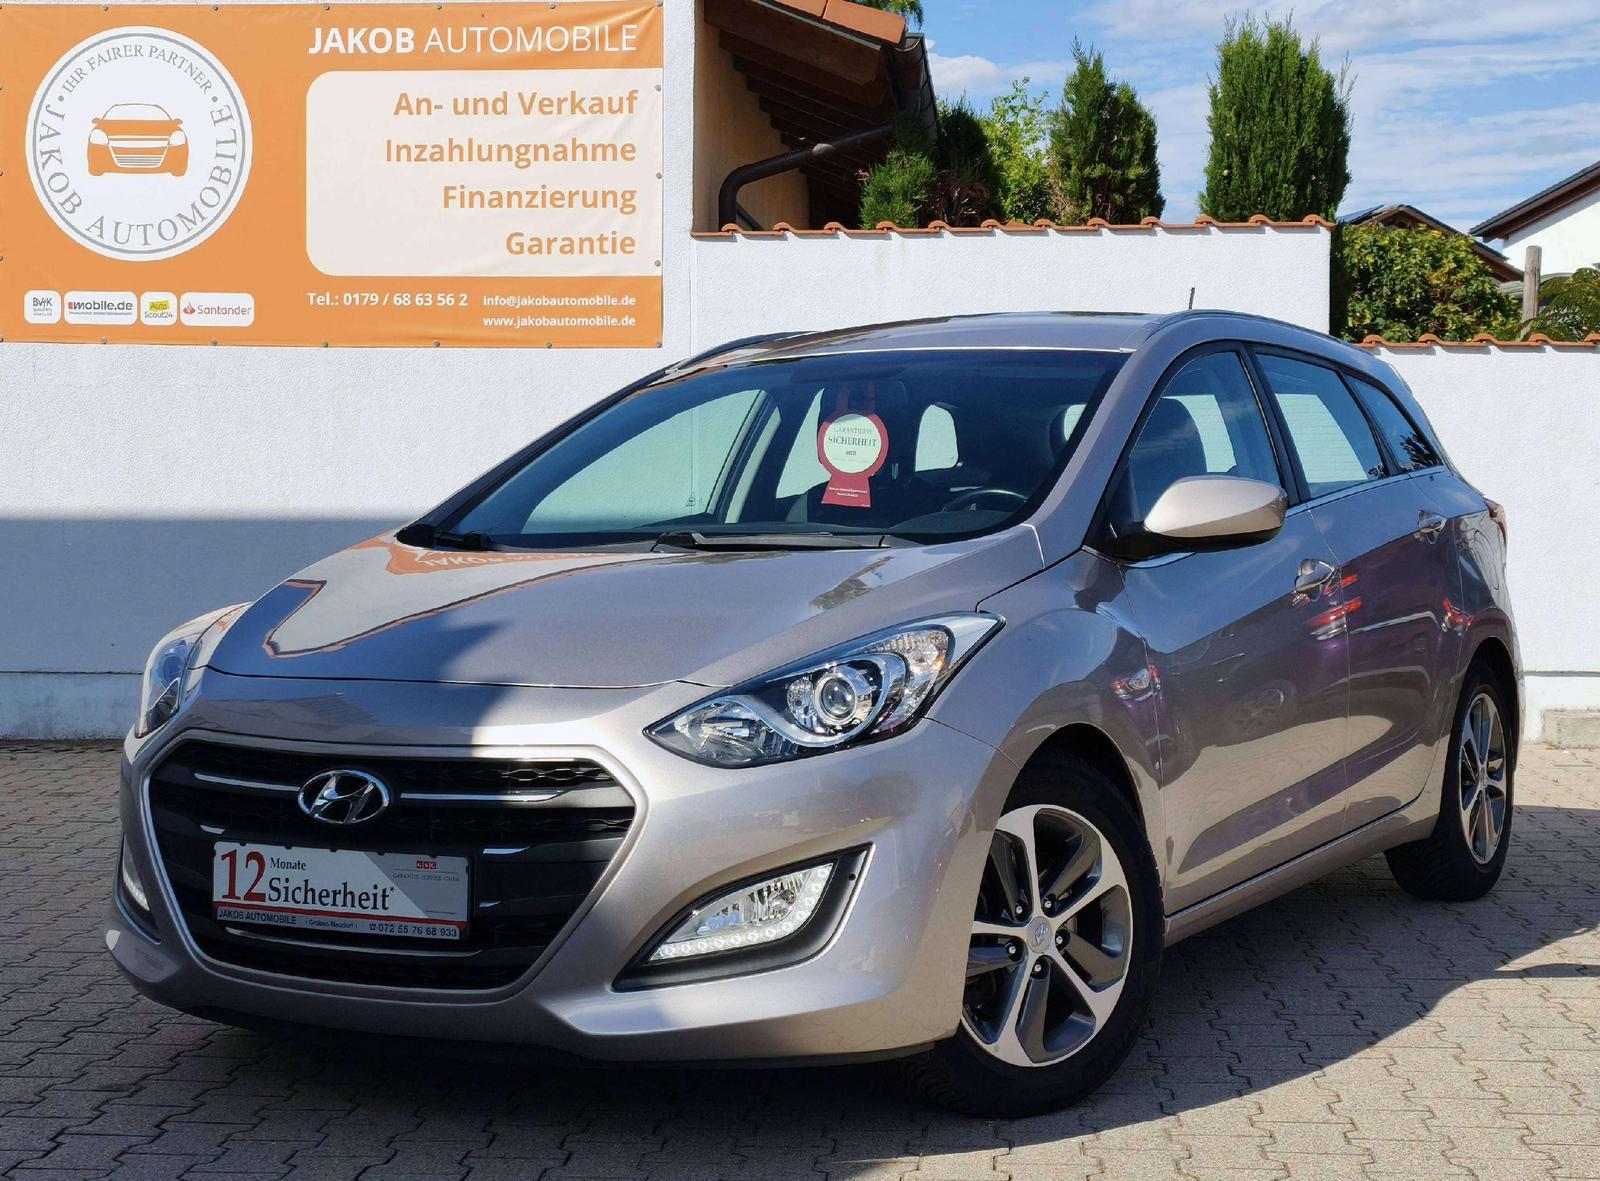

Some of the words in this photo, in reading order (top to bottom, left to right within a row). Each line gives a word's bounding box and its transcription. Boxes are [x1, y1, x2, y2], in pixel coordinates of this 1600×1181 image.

[308, 27, 415, 54] JAKOB
[424, 24, 638, 53] AUTOMOBILE
[62, 67, 88, 95] IHR
[87, 44, 144, 71] FAIRER
[148, 45, 213, 95] PARTNER
[394, 92, 443, 116] An-
[452, 91, 508, 116] und
[517, 89, 639, 115] Verkauf
[386, 138, 637, 169] Inzahlungnahme
[40, 103, 83, 215] JAKOB
[85, 103, 238, 246] AUTOMOBILE
[443, 184, 637, 215] Finanzierung
[505, 230, 636, 255] Garantie
[73, 300, 133, 310] mobile.de
[307, 292, 340, 306] Tel.:
[343, 293, 379, 306] 0179
[382, 293, 389, 306] /
[393, 293, 412, 306] 68
[415, 293, 433, 306] 63
[436, 293, 455, 306] 56
[459, 293, 468, 306] 2
[483, 295, 636, 308] info@jakobautomobile.de
[144, 311, 173, 319] Scout24
[197, 305, 251, 315] Santander
[483, 315, 636, 328] www.jakobautomobile.de
[828, 437, 877, 447] SICHERHEIT
[270, 857, 307, 871] Monate
[221, 849, 267, 902] 12
[219, 909, 244, 920] JAKOB
[246, 911, 297, 925] AUTOMOBILE
[378, 924, 395, 933] 072
[398, 925, 408, 934] 55
[412, 926, 422, 935] 76
[426, 927, 437, 936] 68
[440, 928, 457, 937] 933
